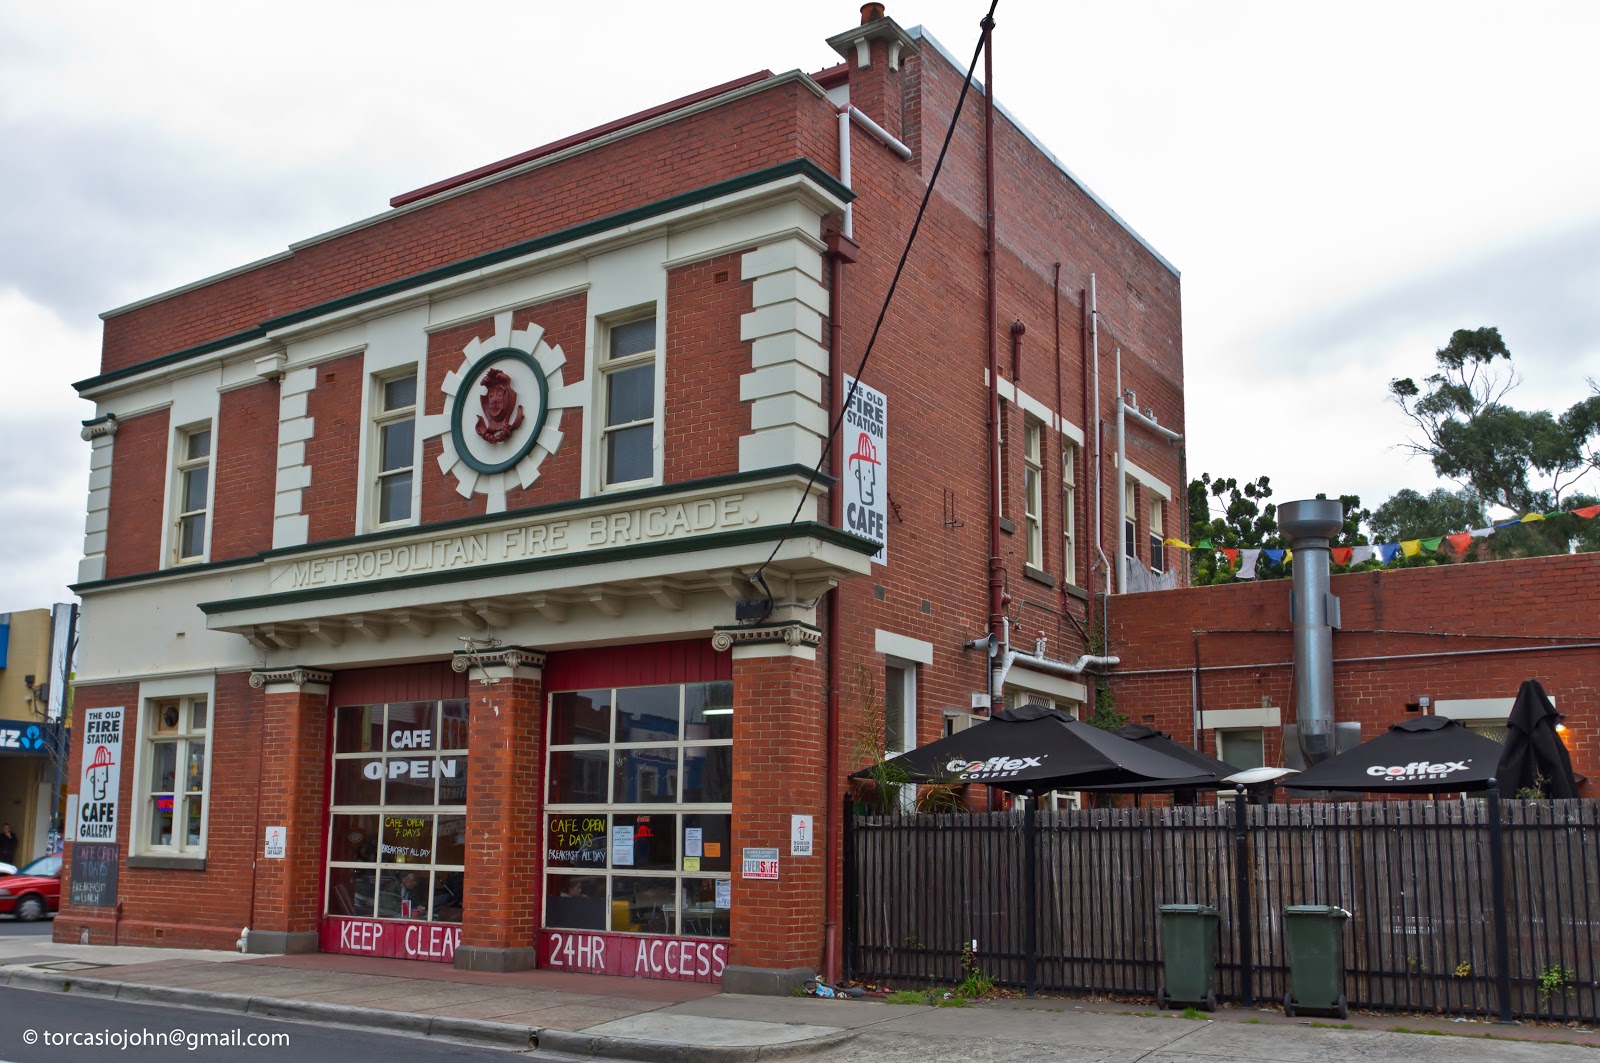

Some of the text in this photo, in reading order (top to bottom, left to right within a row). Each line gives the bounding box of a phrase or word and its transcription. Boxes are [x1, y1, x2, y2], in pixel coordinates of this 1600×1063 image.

[847, 380, 884, 407] THE OLD
[847, 392, 884, 424] FIRE
[846, 410, 884, 439] STATION
[846, 502, 884, 540] CAFE
[292, 533, 488, 588] METROPOLITAN
[502, 520, 568, 558] FIRE
[88, 711, 120, 720] THE OLD
[87, 720, 120, 733] FIRE
[86, 733, 120, 745] STATION
[390, 729, 431, 748] CAFE
[364, 760, 457, 780] OPEN
[960, 770, 1019, 780] COFFEE
[1384, 773, 1448, 781] COFFEE
[82, 802, 114, 822] CAFE
[384, 817, 425, 828] CAFE OPEN
[550, 818, 605, 833] CAFE OPEN
[80, 824, 114, 839] GALLERY
[394, 828, 422, 838] 7 DAYS
[558, 833, 593, 848] 7 DAYS
[381, 844, 431, 858] BREAKFAST ALL DAY
[548, 848, 580, 861] BREAKFAST
[581, 850, 592, 861] ALL
[593, 851, 606, 862] DAY
[340, 920, 382, 951] KEEP
[550, 932, 725, 977] 24HR ACCESS
